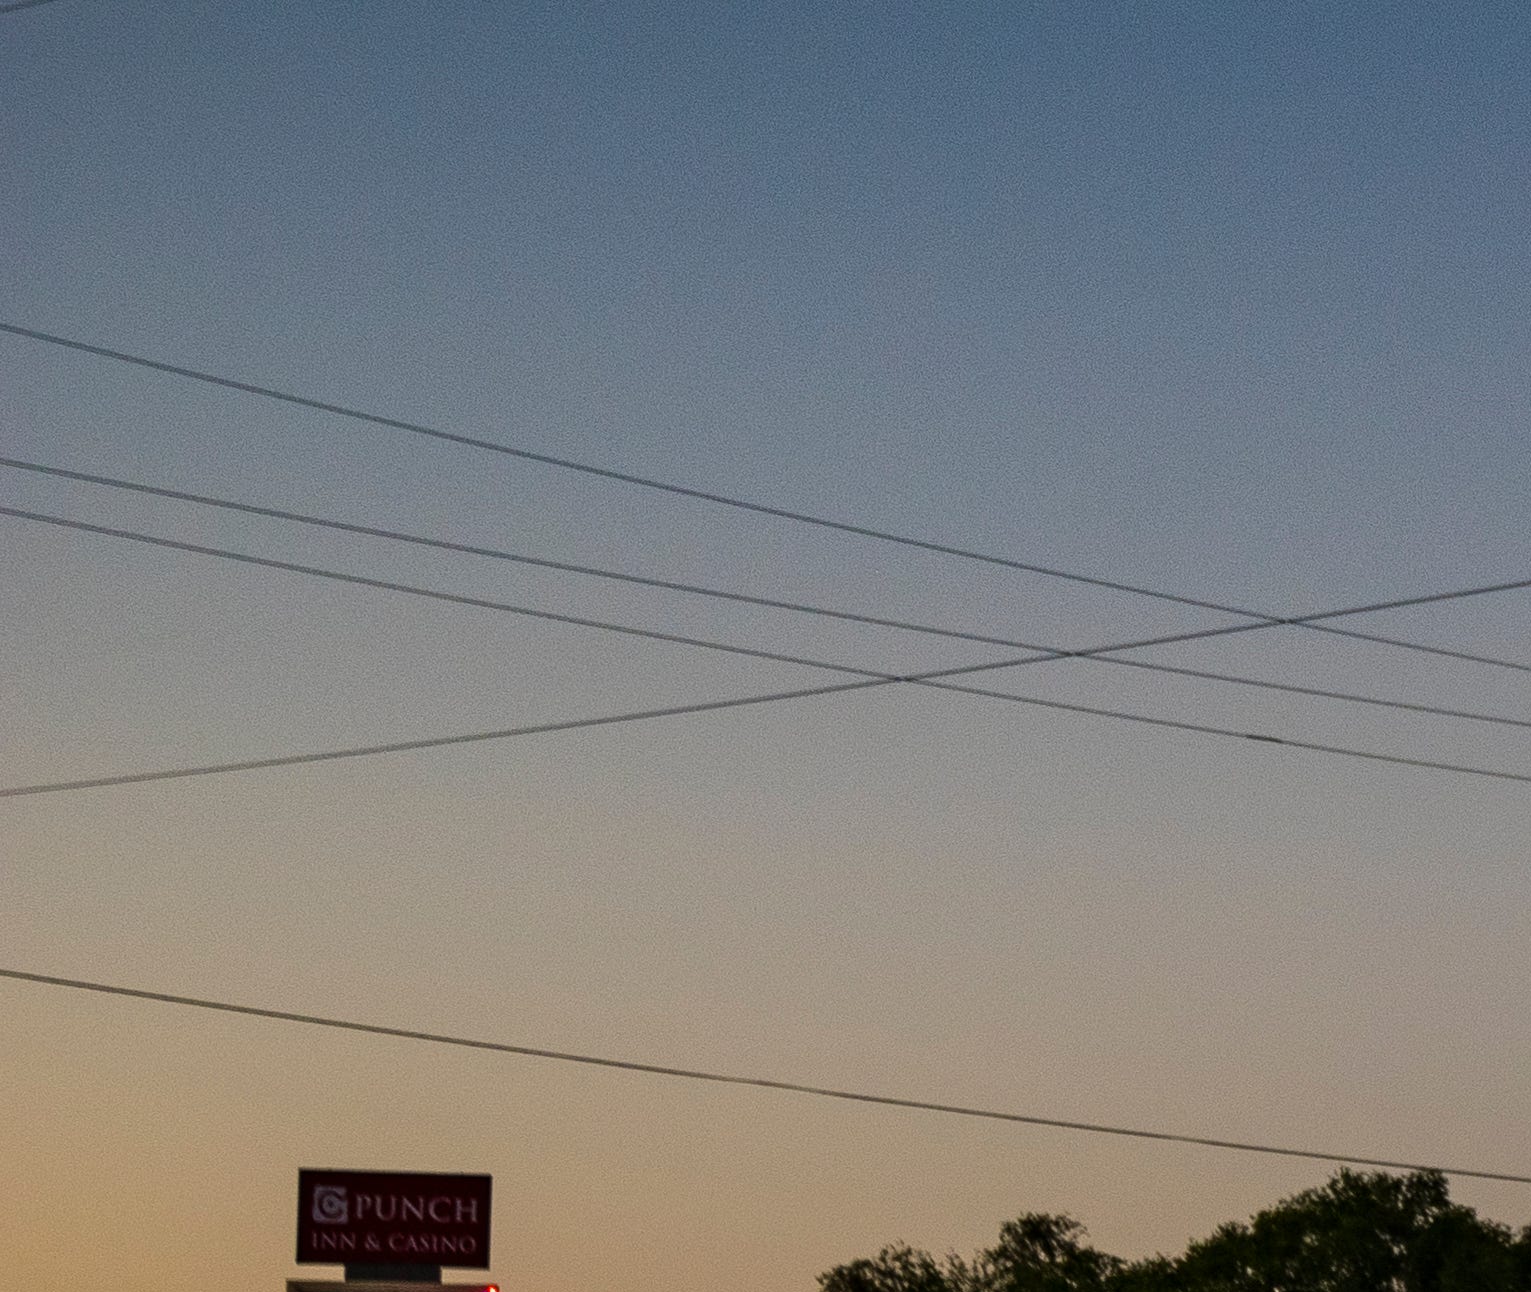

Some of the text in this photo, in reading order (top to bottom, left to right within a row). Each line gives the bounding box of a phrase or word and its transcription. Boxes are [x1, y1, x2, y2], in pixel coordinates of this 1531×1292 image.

[353, 1193, 479, 1224] PUNCH
[311, 1229, 478, 1254] INN & CASINO
